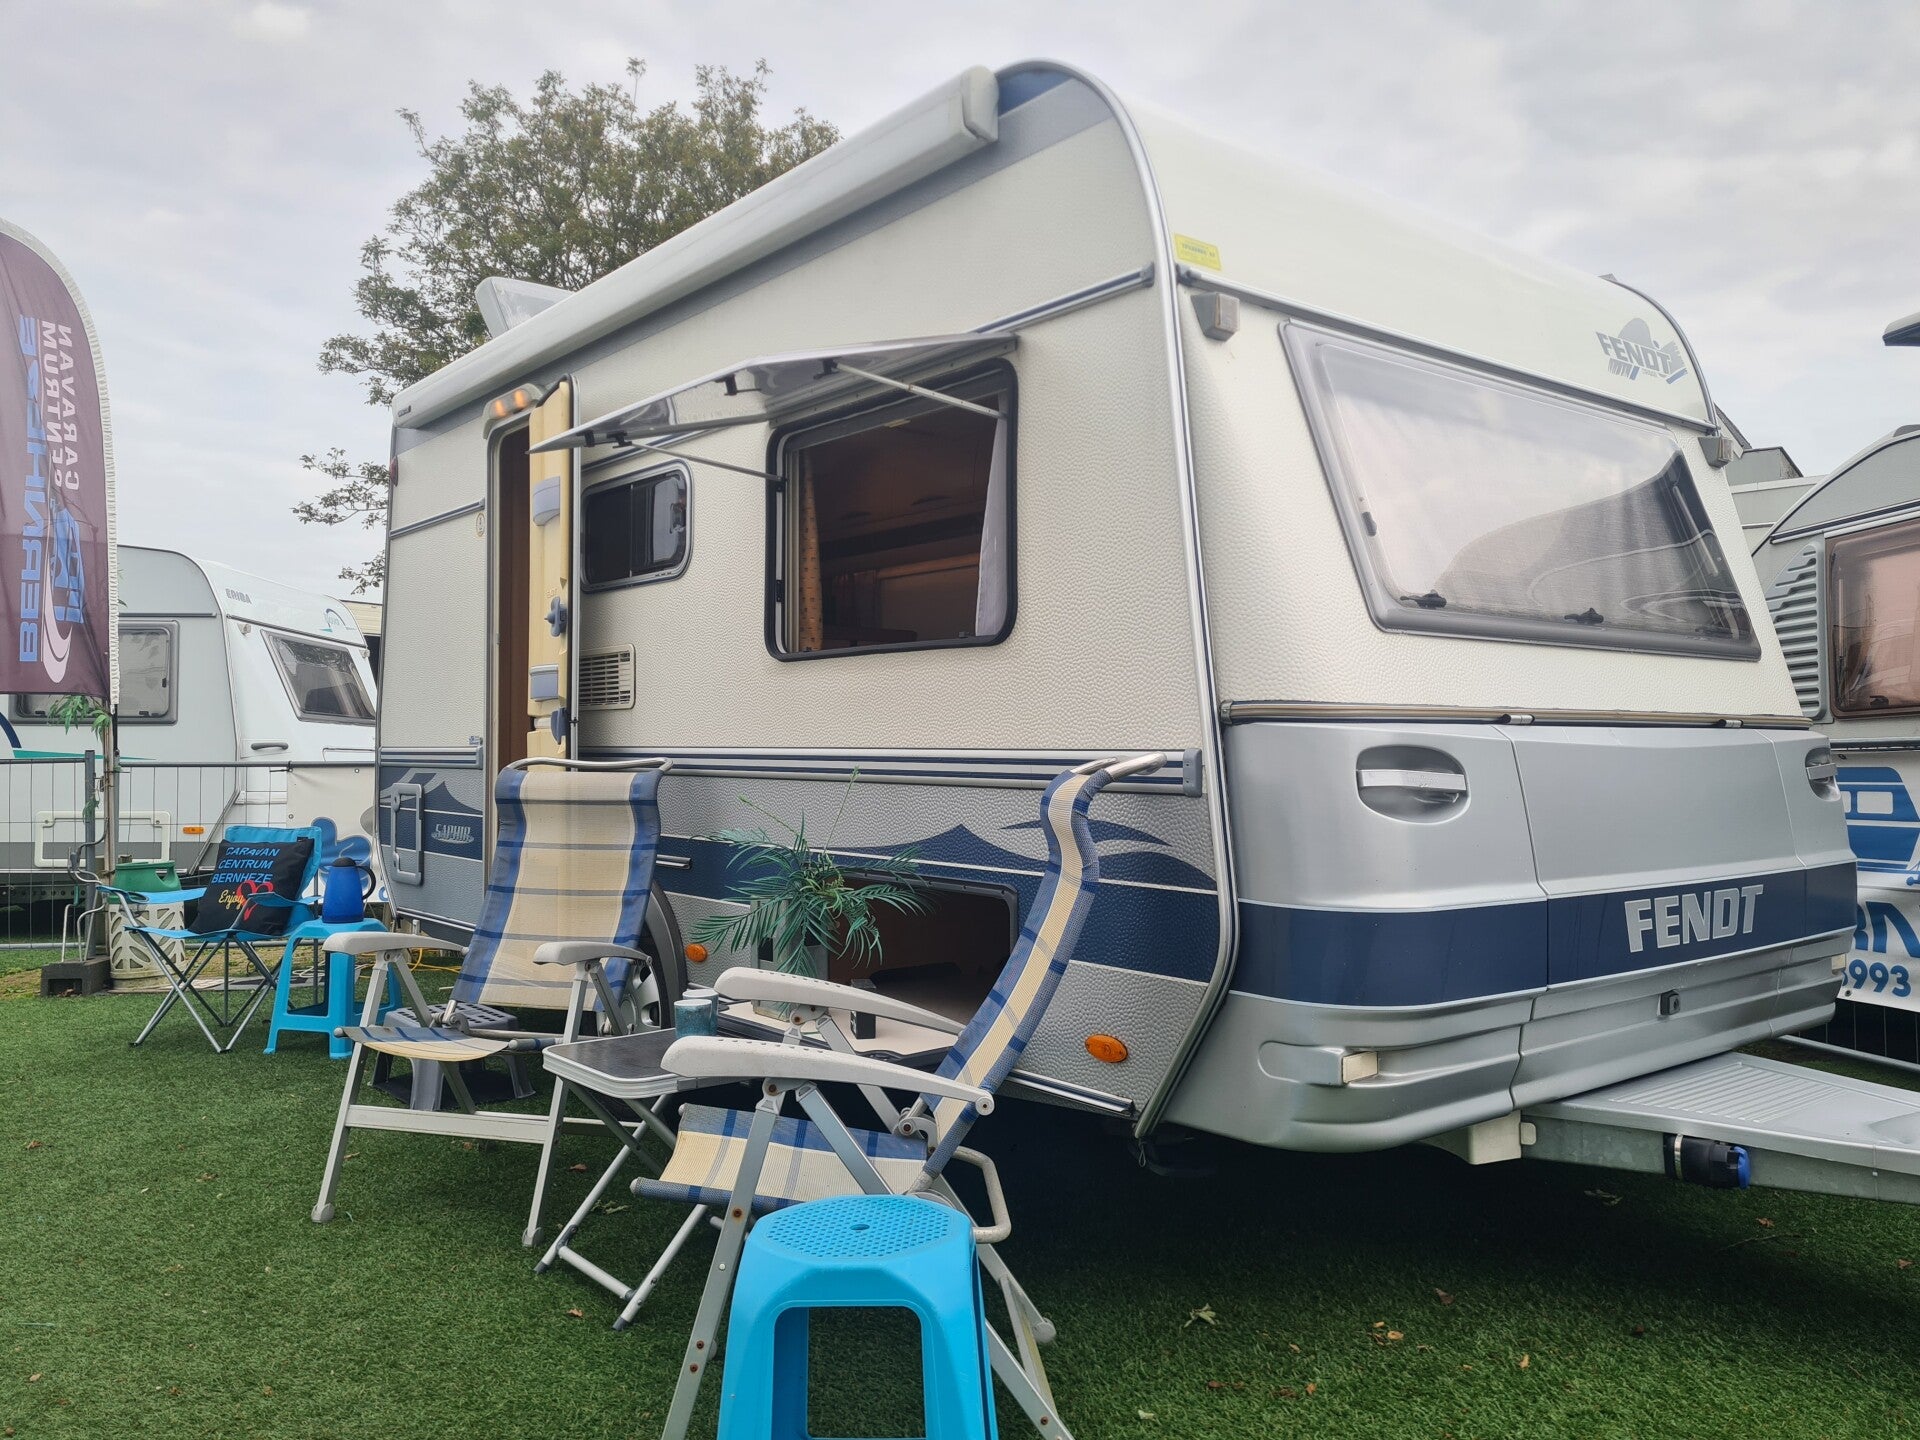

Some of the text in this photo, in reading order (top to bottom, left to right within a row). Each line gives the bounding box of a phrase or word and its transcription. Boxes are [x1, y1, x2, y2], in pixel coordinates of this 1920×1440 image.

[1595, 331, 1671, 375] FENDT
[226, 847, 281, 857] CARAVAN
[218, 859, 274, 870] CENTRUM
[211, 872, 274, 884] BERNHEZE
[218, 889, 246, 910] Enjoy
[1624, 884, 1764, 953] FENDT
[1841, 958, 1912, 998] 993
